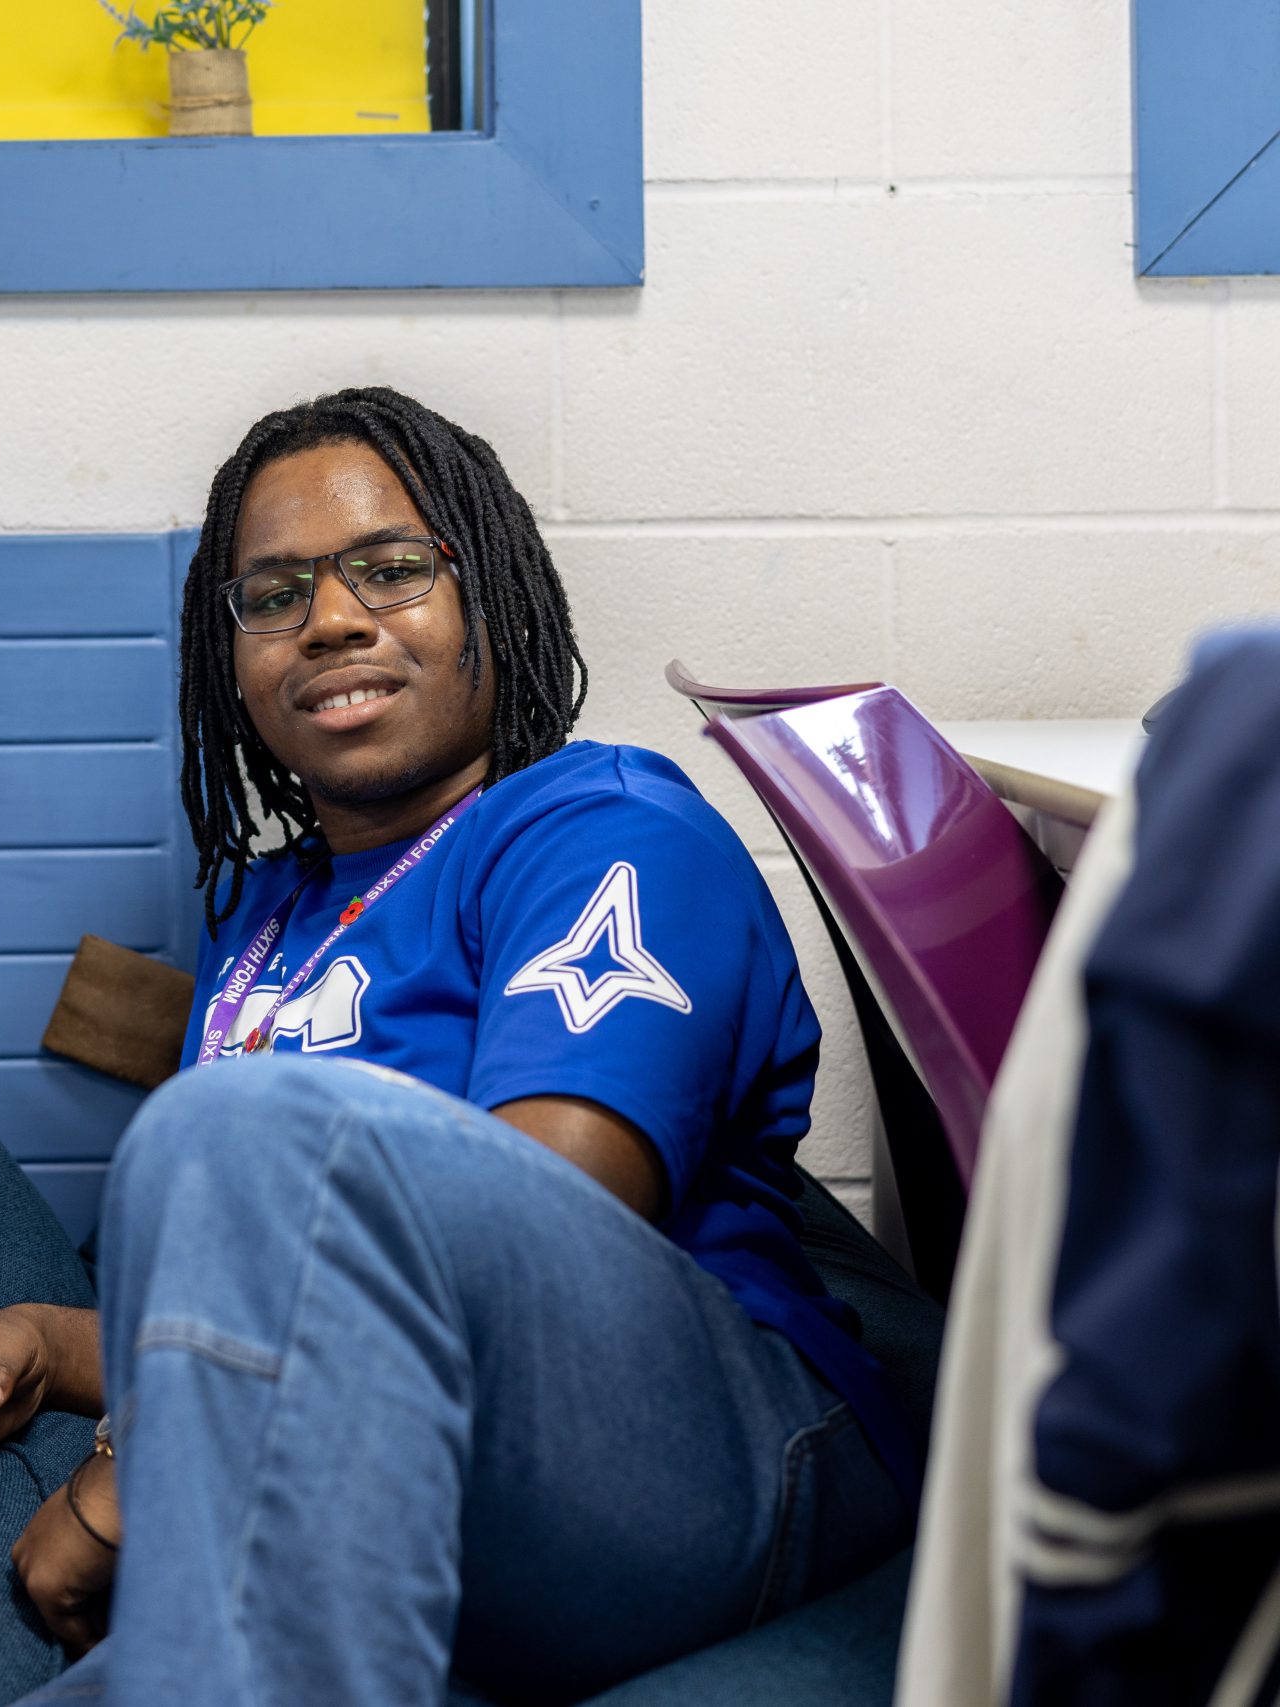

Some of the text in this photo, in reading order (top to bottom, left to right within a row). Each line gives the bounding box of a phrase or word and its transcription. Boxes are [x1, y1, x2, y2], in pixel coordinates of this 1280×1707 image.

[366, 858, 413, 900] SIXTH
[249, 918, 280, 965] SIXTH
[223, 960, 257, 1004] FORM
[267, 971, 305, 1017] SIXTH
[305, 924, 348, 968] FORM
[201, 1029, 223, 1066] SIXT
